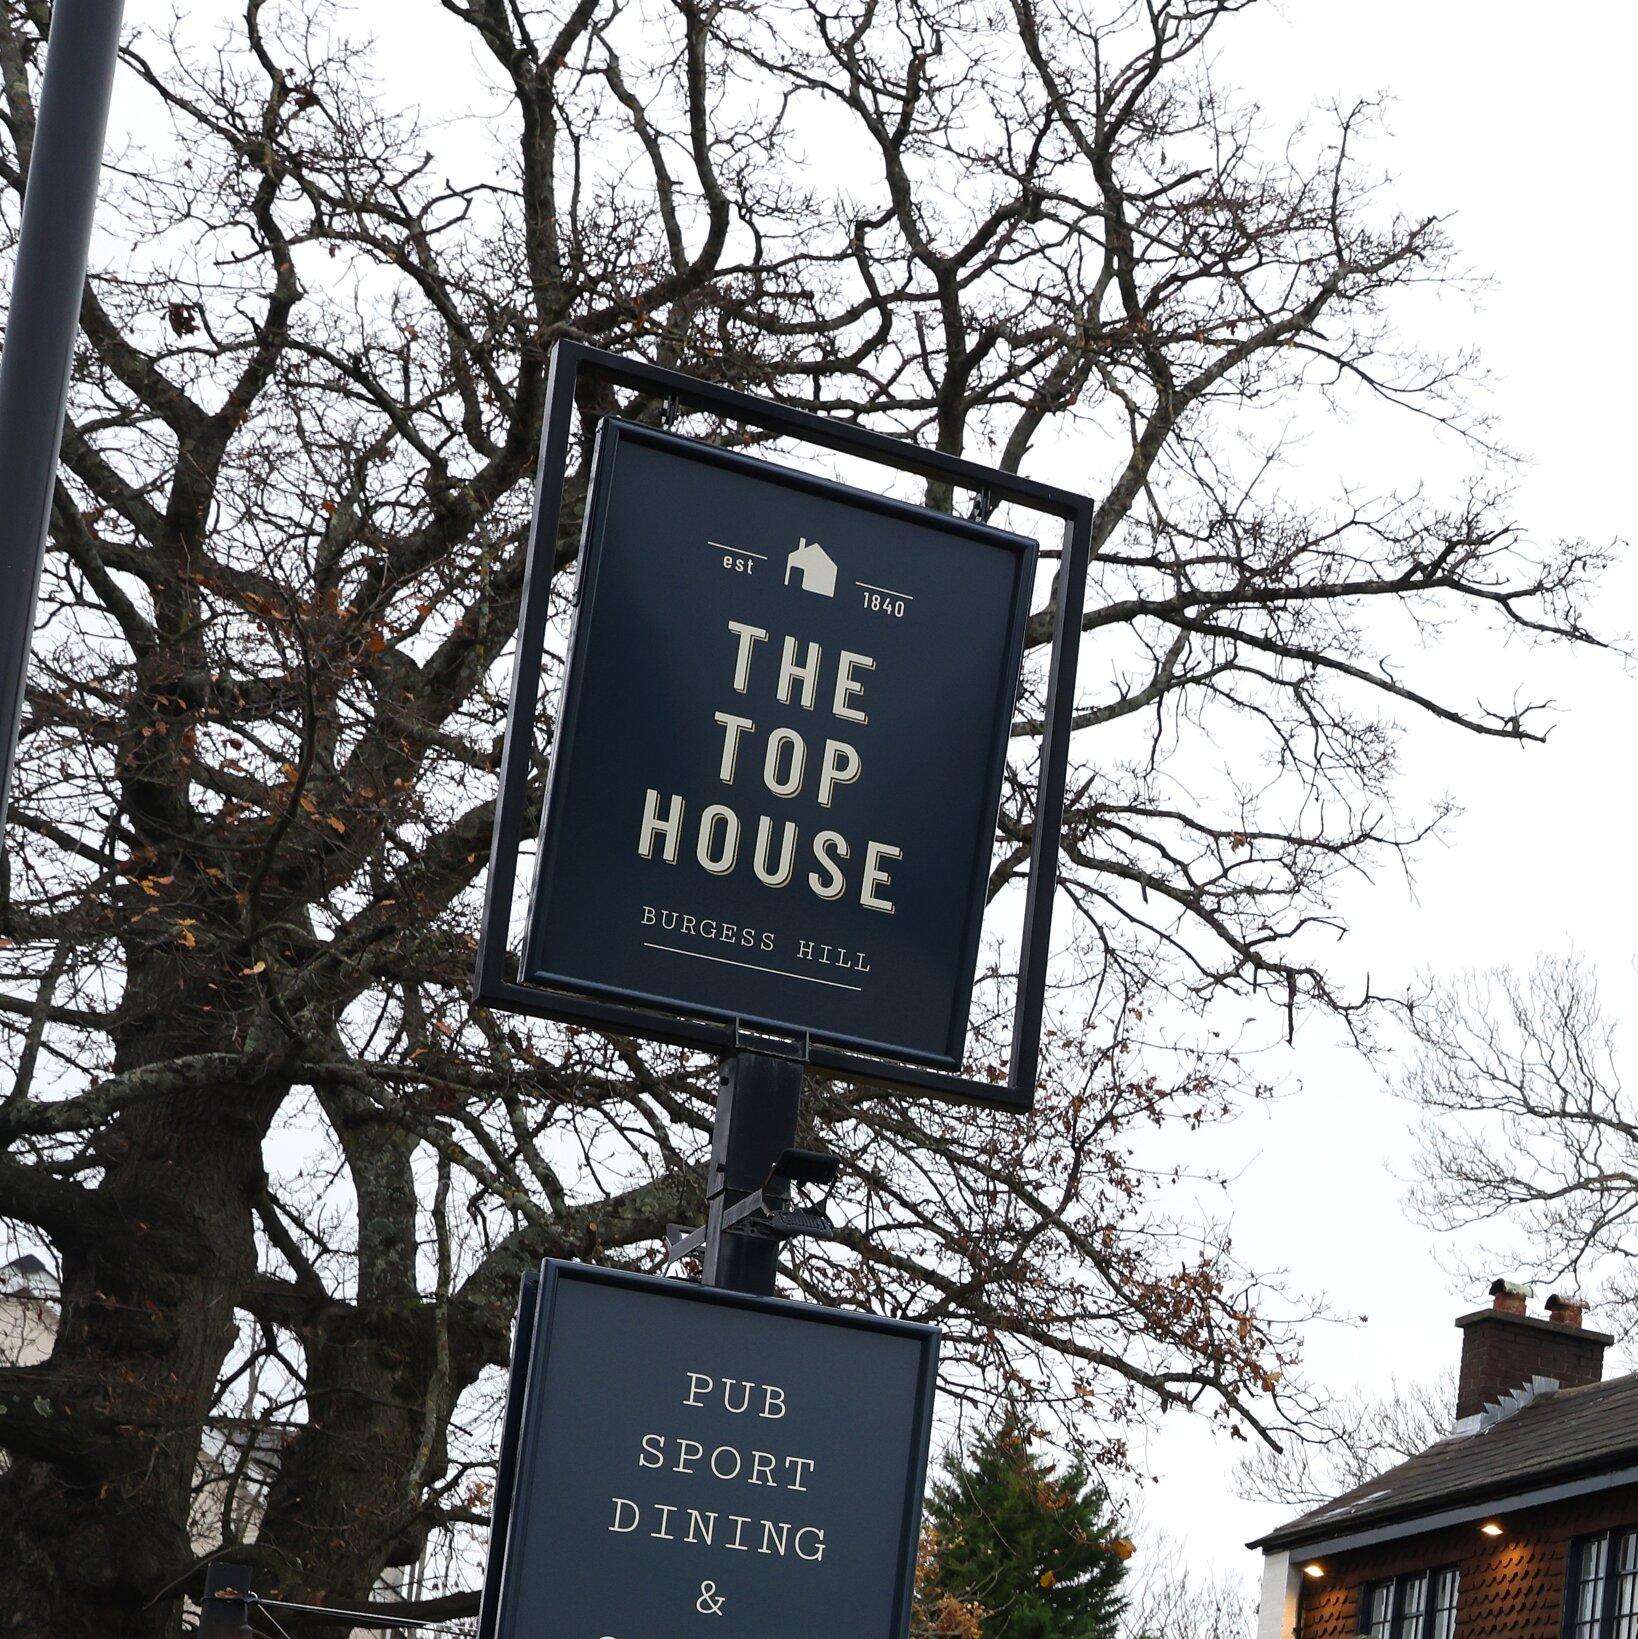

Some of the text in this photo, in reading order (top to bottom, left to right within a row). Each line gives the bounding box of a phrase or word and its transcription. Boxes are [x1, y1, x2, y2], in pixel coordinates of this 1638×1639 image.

[722, 551, 906, 618] est 1840
[727, 620, 876, 724] THE
[713, 711, 862, 808] TOP
[638, 788, 902, 914] HOUSE
[641, 906, 871, 973] BURGESS HILL
[683, 1372, 786, 1419] PUB
[639, 1434, 815, 1491] SPORT
[608, 1498, 827, 1561] DINING
[696, 1580, 726, 1616] &
